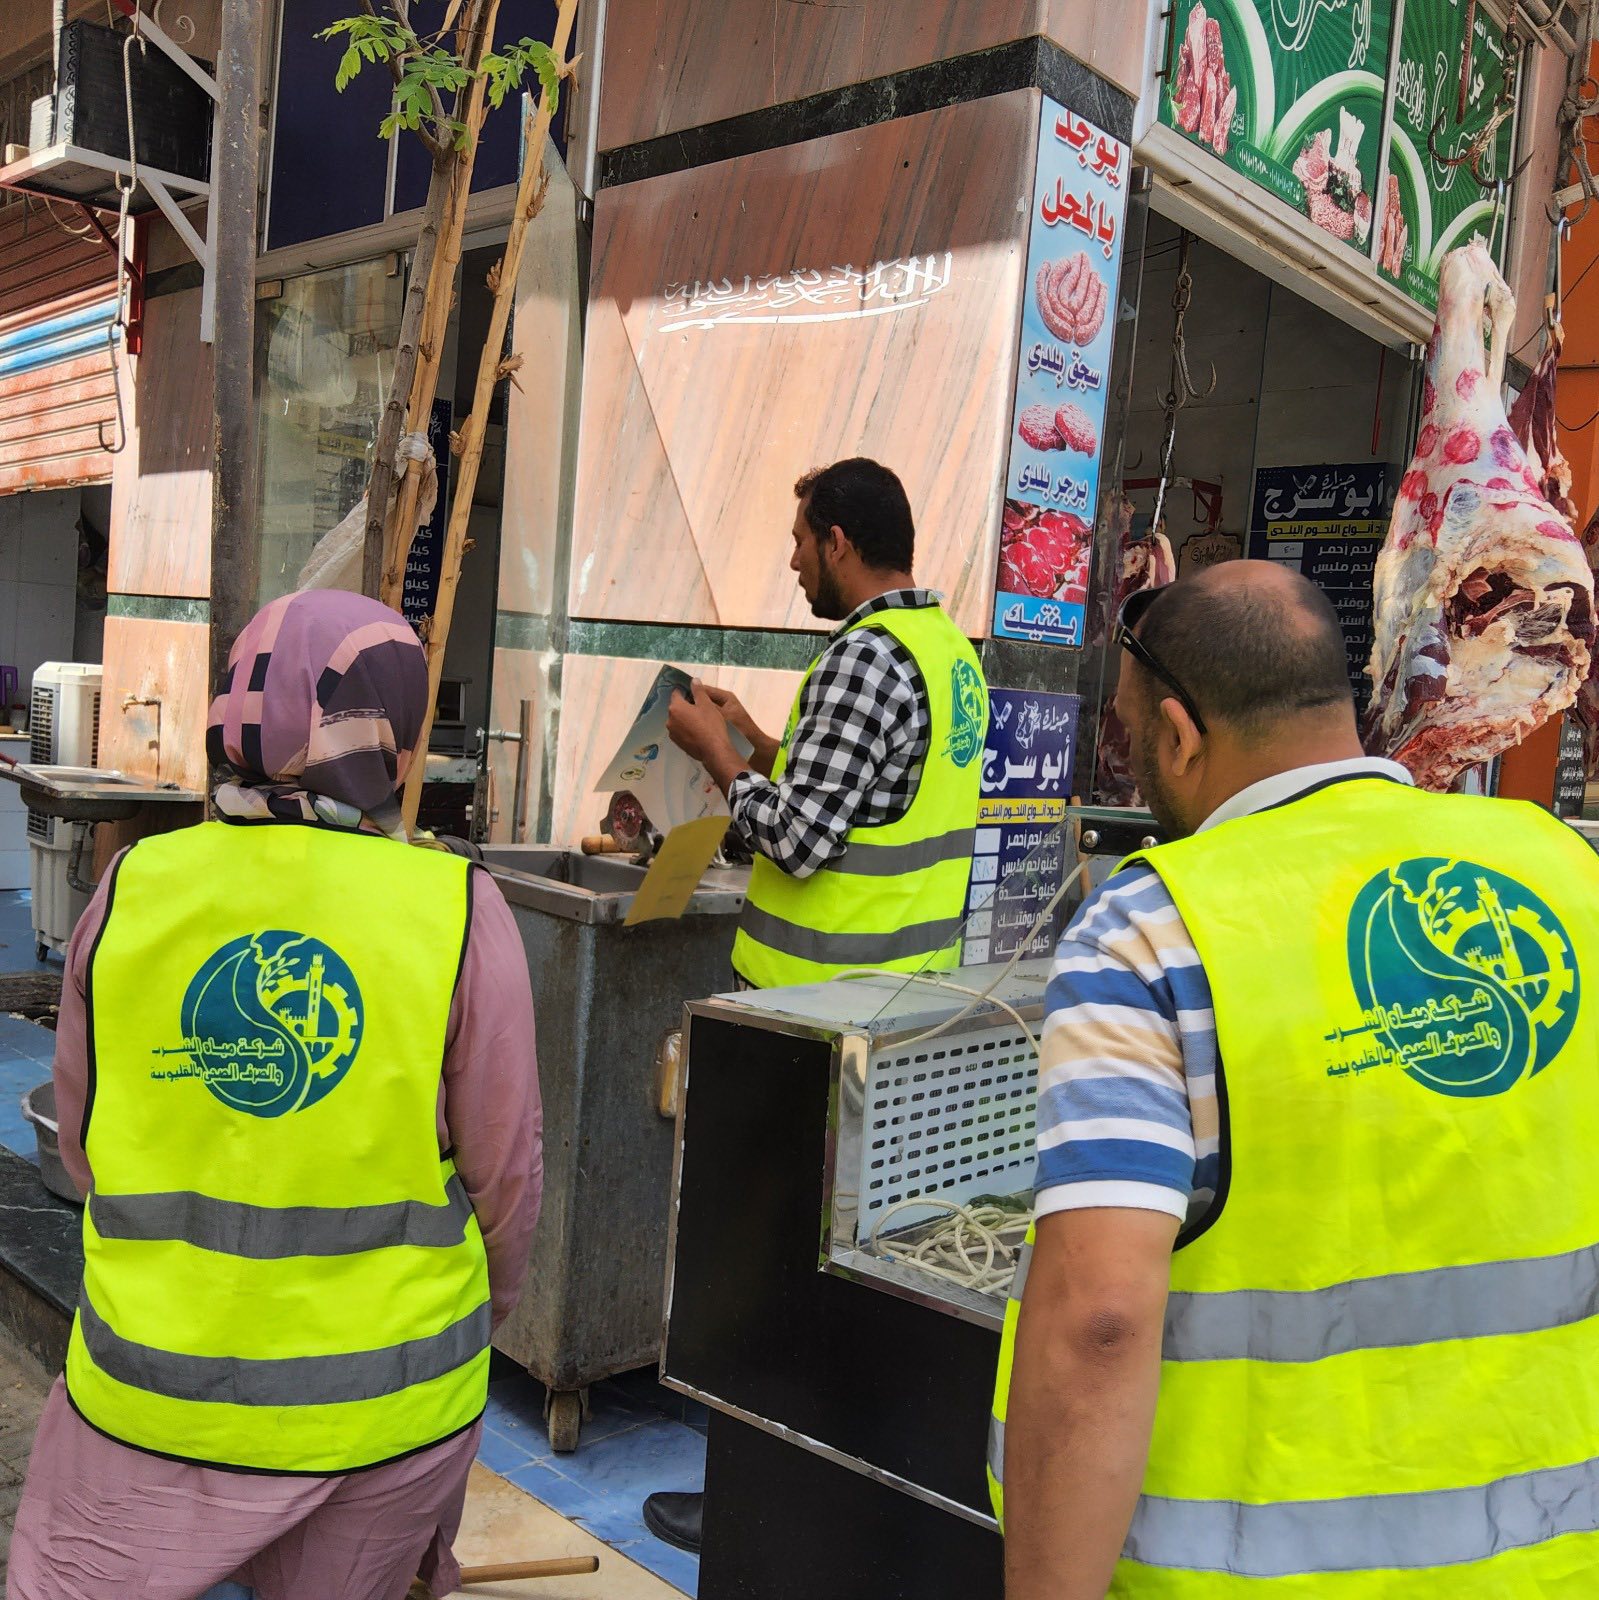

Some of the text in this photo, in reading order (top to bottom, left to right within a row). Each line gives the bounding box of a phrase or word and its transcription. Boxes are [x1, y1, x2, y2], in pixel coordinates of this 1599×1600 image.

[1055, 110, 1121, 187] يوجد
[1041, 177, 1116, 259] بالمحل
[1067, 349, 1101, 392] سجق
[1322, 470, 1355, 490] جزارة
[1051, 476, 1088, 510] برجر
[1264, 470, 1384, 520] أبو سرج
[1304, 525, 1340, 537] اللحوم
[408, 543, 430, 557] كيل
[1317, 543, 1373, 556] لحم أحمر
[406, 561, 431, 573] كيلو
[1350, 561, 1374, 574] لحم
[405, 578, 430, 591] كيلو
[404, 596, 429, 608] كيلو
[1333, 597, 1370, 609] بوفتي
[1003, 603, 1077, 645] بفتيك
[1339, 615, 1365, 627] استي
[1042, 705, 1070, 733] جزارة
[981, 734, 1071, 792] أبو سرج
[1006, 829, 1027, 851] أحمر
[1027, 830, 1042, 850] لحم
[1026, 857, 1041, 876] لحم
[1041, 856, 1058, 875] كيلو
[1038, 882, 1056, 901] كيلو
[1032, 934, 1049, 953] كيلو
[1387, 1002, 1432, 1029] مياه
[1429, 988, 1493, 1022] شركة
[202, 1037, 237, 1058] مياه
[237, 1037, 285, 1059] شركة
[1441, 1021, 1501, 1057] والصرف
[1326, 1041, 1395, 1079] بالقليوبية
[150, 1061, 203, 1082] بالقليوبية
[240, 1062, 283, 1086] والصرف
